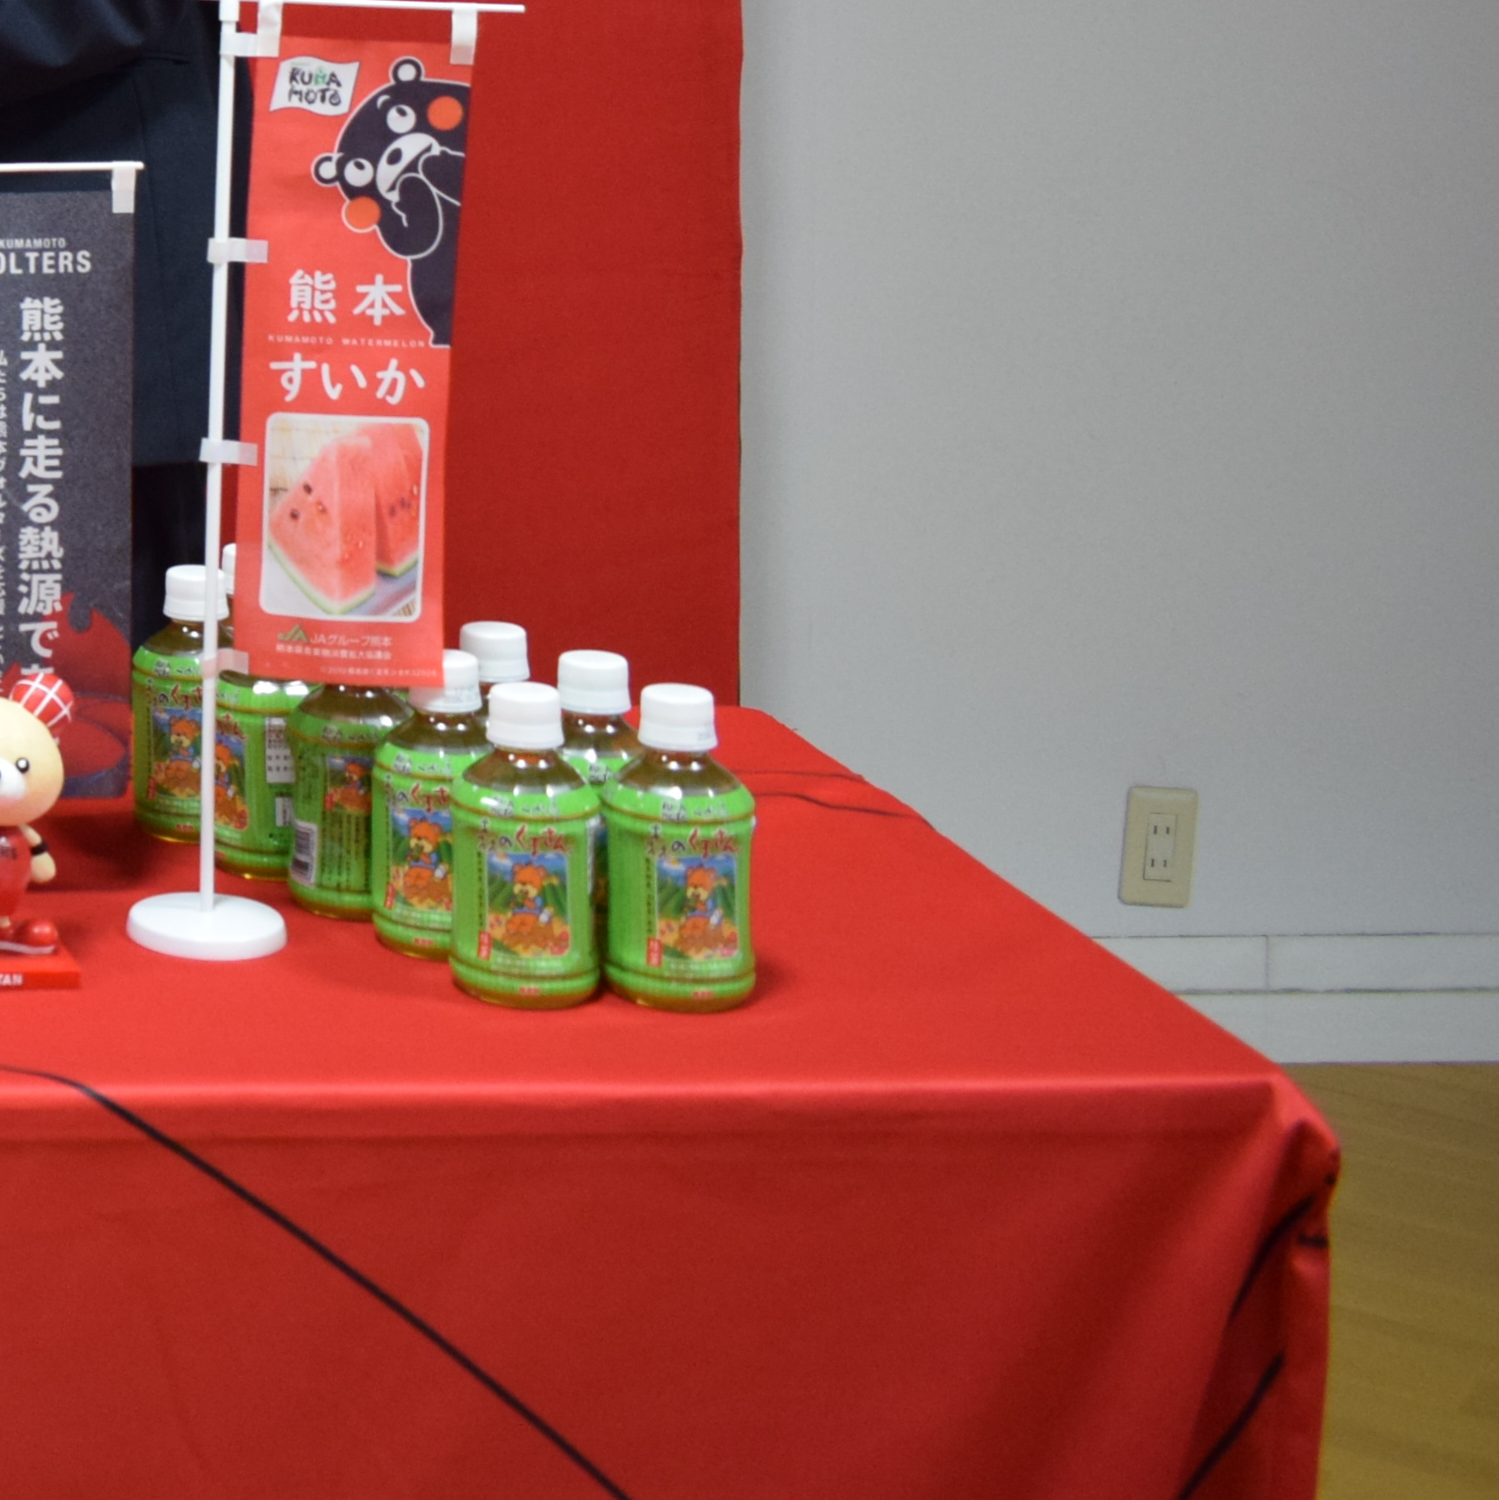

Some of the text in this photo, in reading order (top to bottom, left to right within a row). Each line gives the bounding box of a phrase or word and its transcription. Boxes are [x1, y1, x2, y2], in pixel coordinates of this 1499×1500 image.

[288, 87, 342, 107] MOTO
[287, 269, 406, 326] 熊本
[268, 335, 426, 347] KUMAMOTO WATERMELON
[269, 352, 426, 405] すいか
[309, 633, 393, 647] JAグループ熊本
